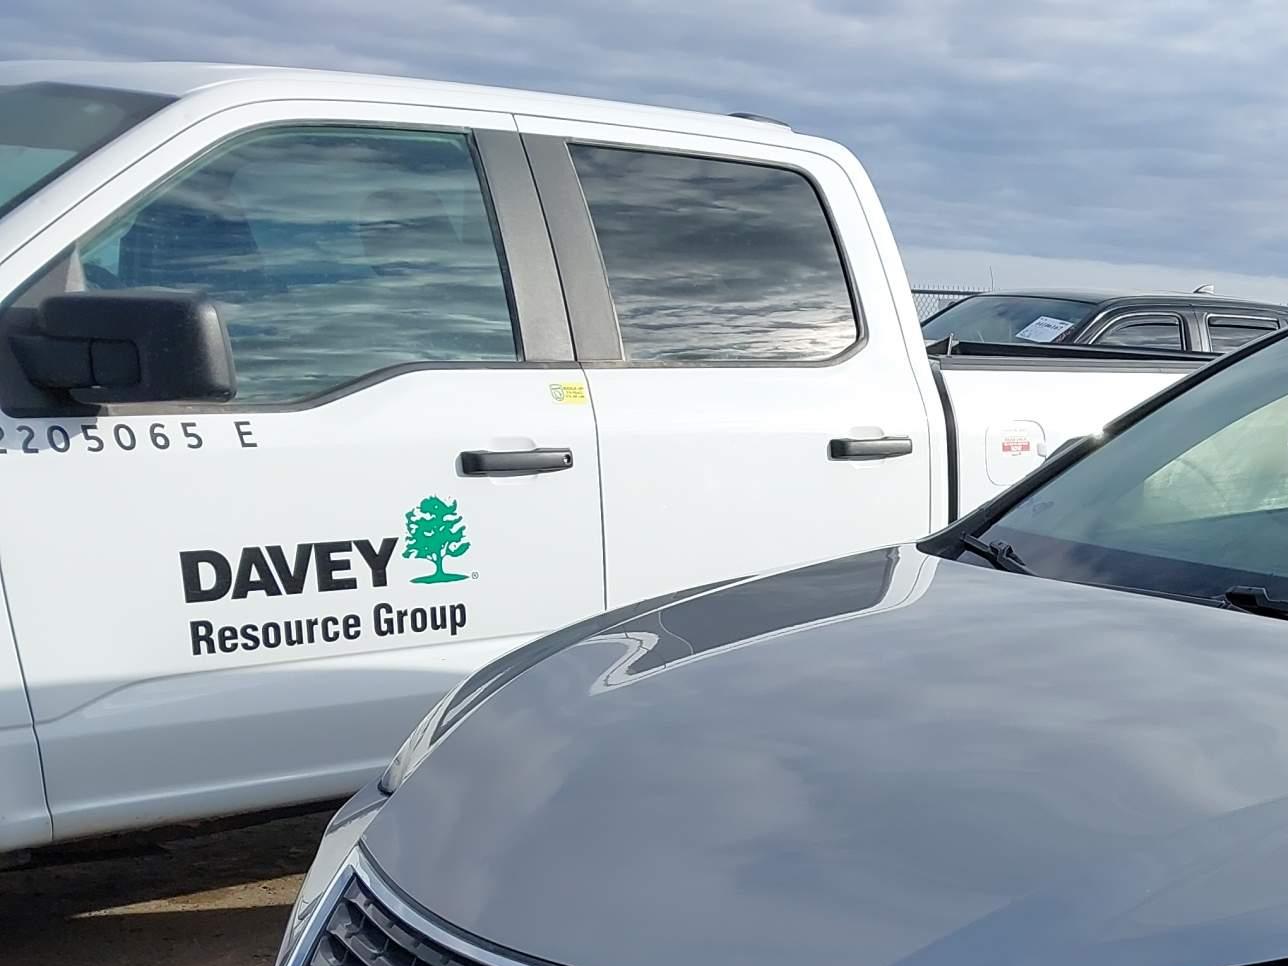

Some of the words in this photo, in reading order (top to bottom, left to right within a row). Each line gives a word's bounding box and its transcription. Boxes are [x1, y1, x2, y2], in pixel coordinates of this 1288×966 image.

[234, 421, 258, 448] E
[179, 536, 399, 604] DAVEY
[189, 612, 361, 656] Resource
[373, 602, 467, 636] Group
